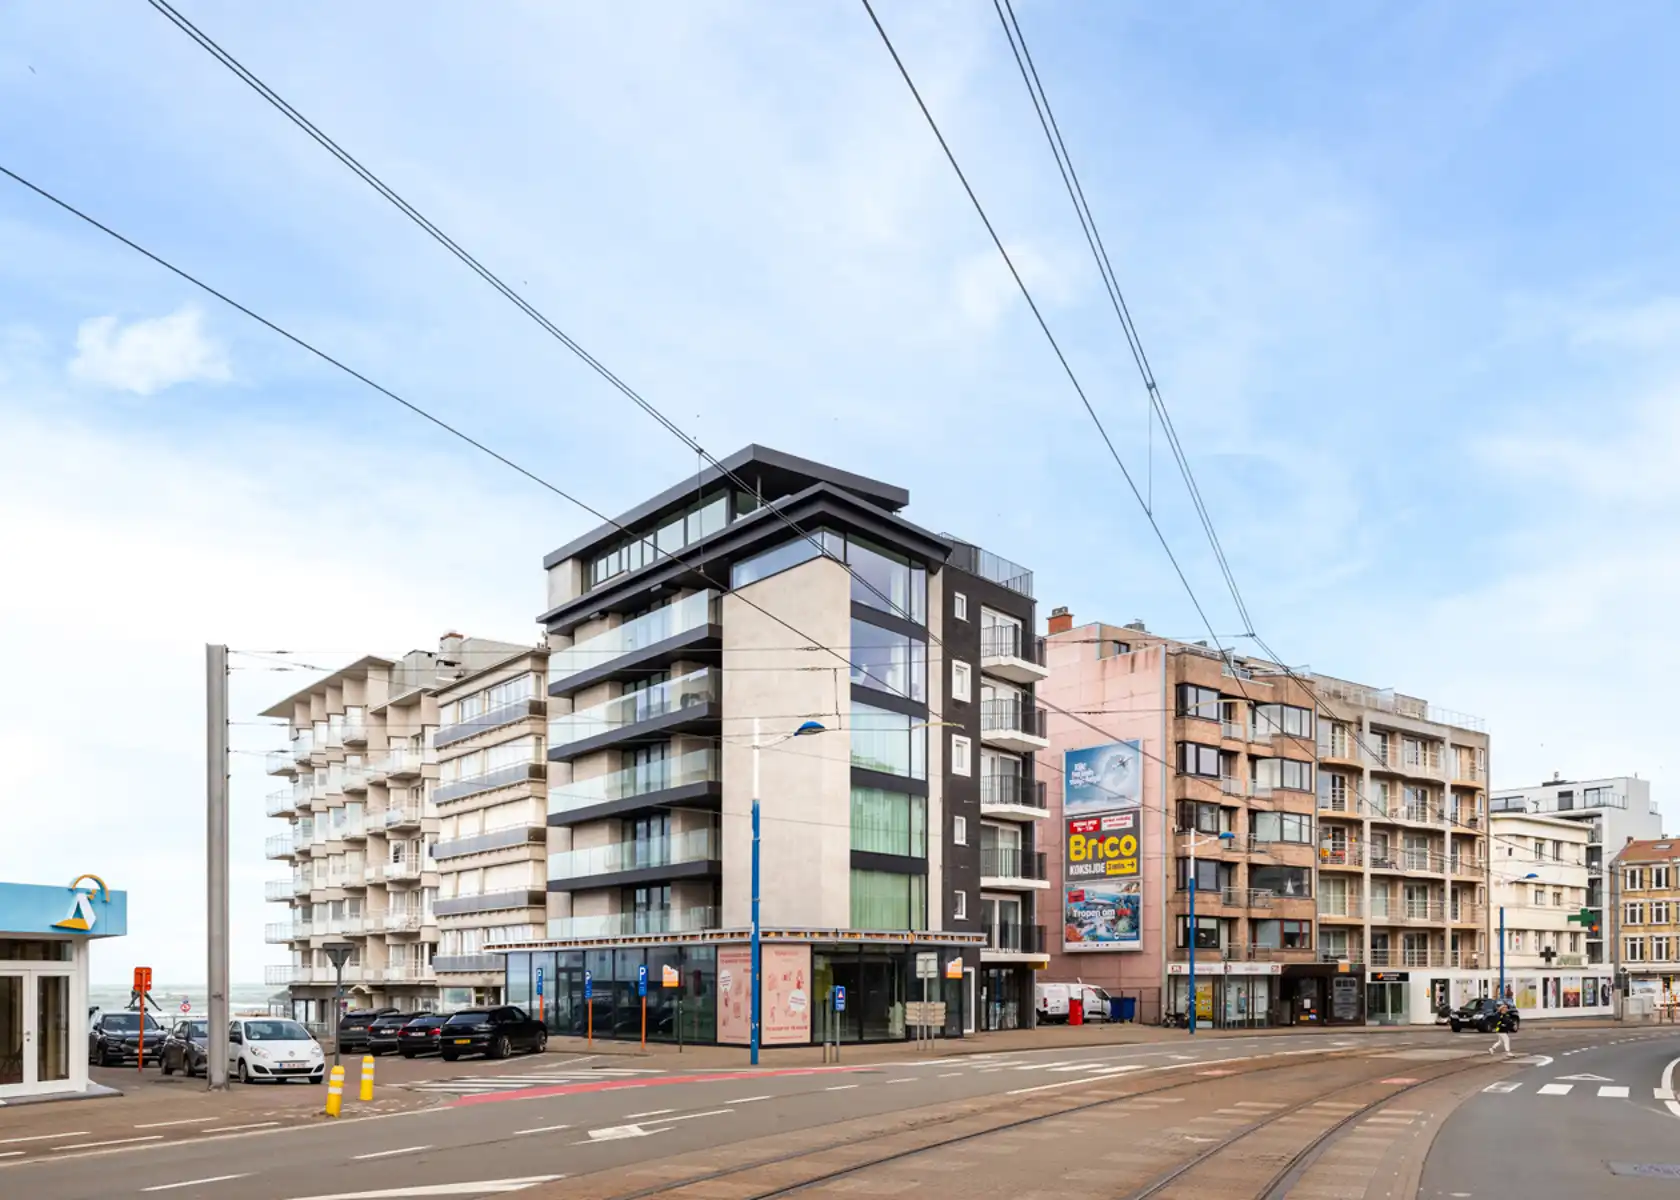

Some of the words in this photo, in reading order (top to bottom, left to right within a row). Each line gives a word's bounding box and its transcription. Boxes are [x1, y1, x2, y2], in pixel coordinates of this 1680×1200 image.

[1069, 834, 1137, 861] Brico
[1069, 862, 1105, 875] KOKSIJDE
[1073, 909, 1100, 919] Tropen
[537, 968, 542, 981] P
[639, 966, 646, 981] P
